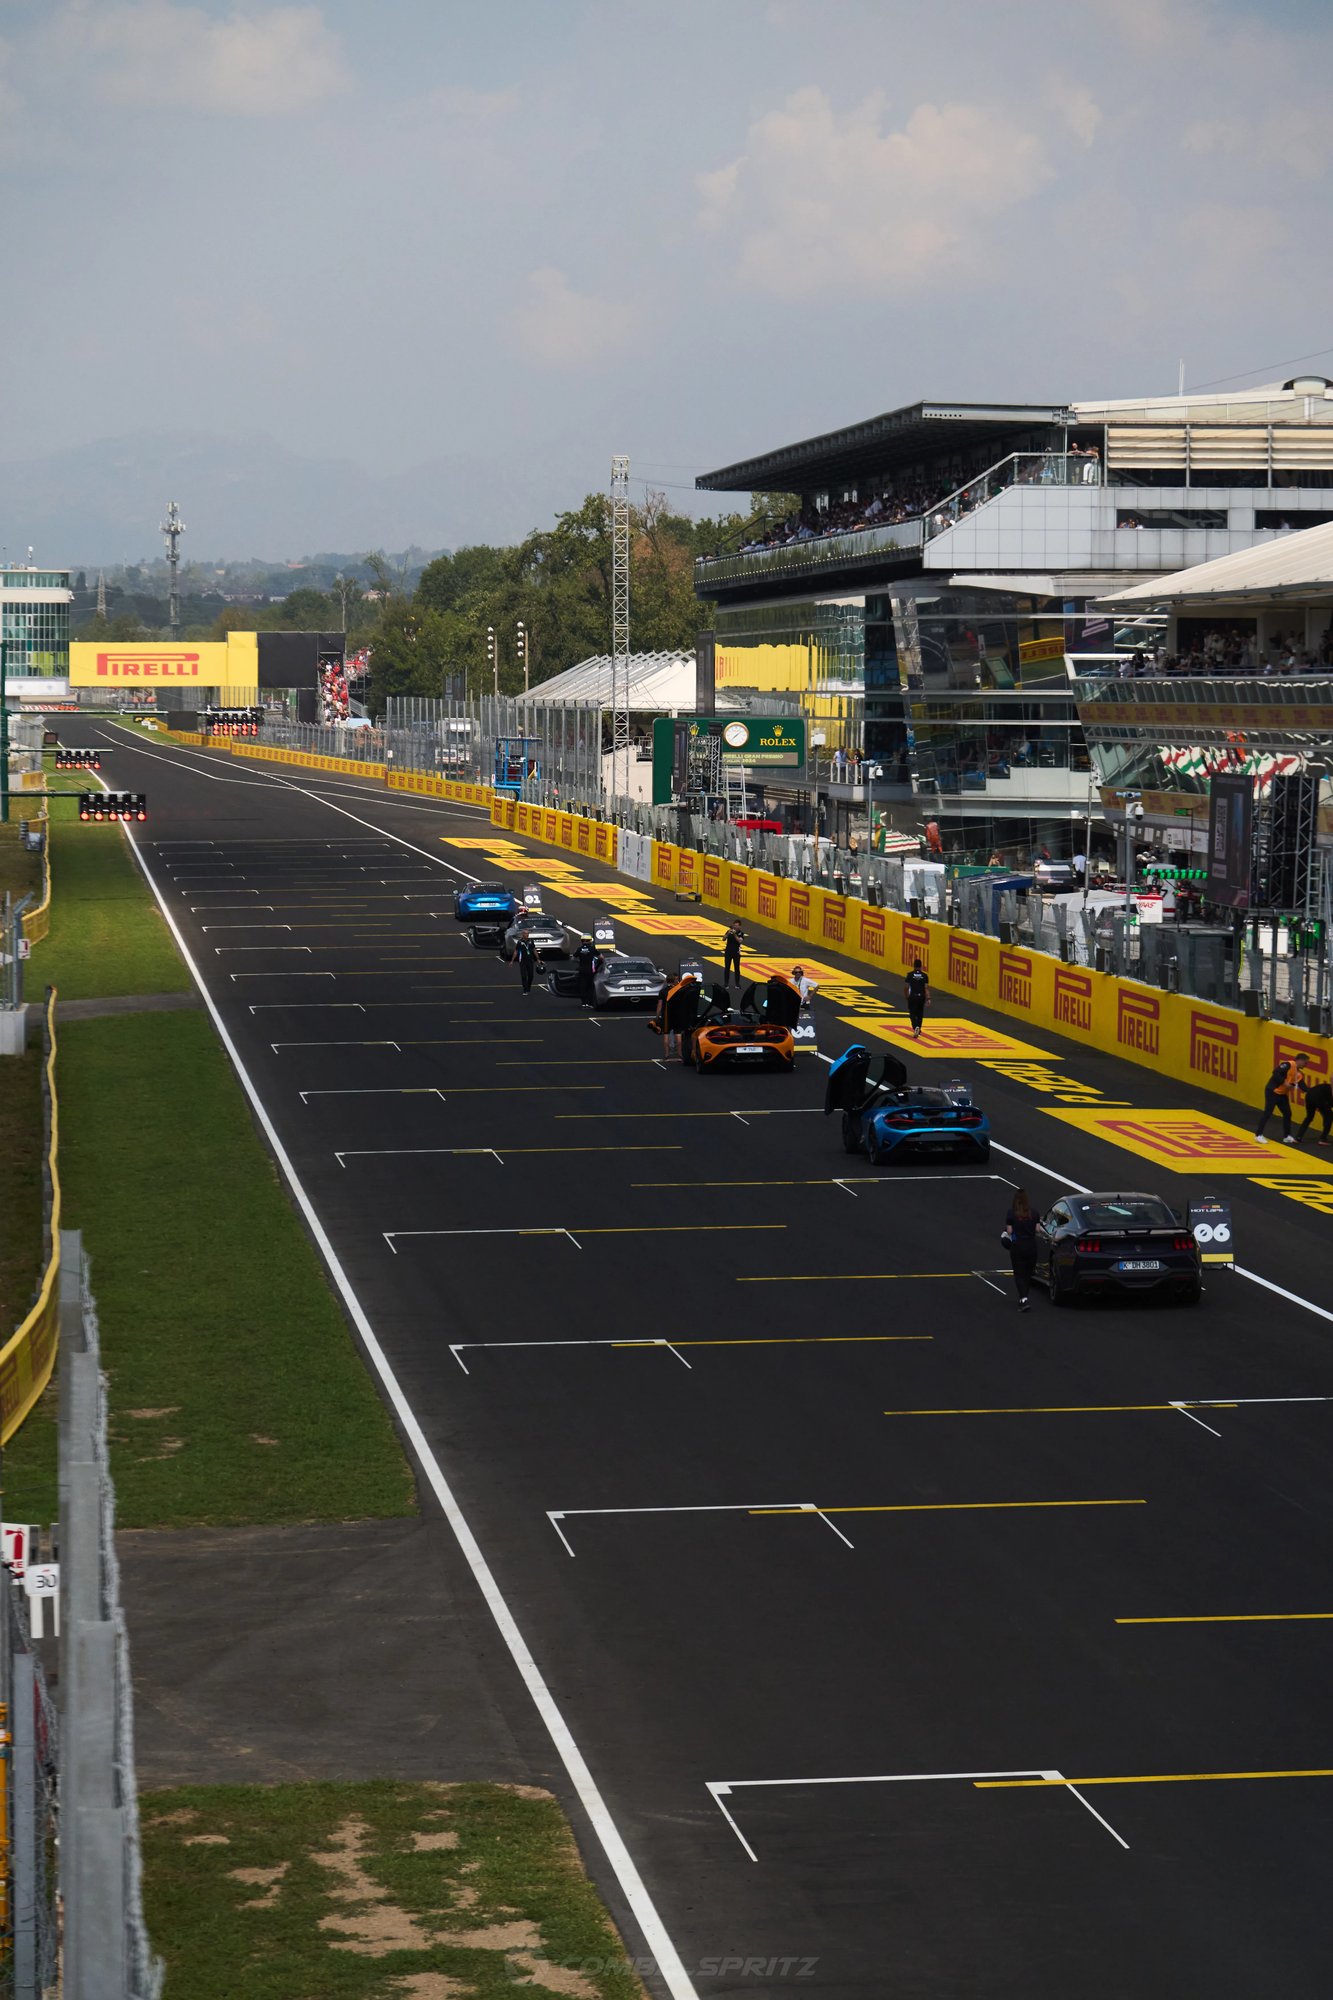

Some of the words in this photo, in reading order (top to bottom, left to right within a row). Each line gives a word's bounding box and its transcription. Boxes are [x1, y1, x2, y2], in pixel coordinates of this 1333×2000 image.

[96, 653, 200, 676] PIRELLI
[760, 738, 796, 746] ROLEX
[703, 860, 720, 899] PIRELLI
[730, 869, 747, 908] PIRELLI
[758, 878, 776, 919] PIRELLI
[525, 895, 540, 904] 01
[789, 886, 810, 931] PIRELLI
[596, 930, 614, 940] 02
[823, 897, 846, 944] PIRELLI
[860, 908, 885, 957] PIRELLI
[948, 934, 978, 990] PIRELLI
[999, 951, 1032, 1009] PIRELLI
[1054, 968, 1092, 1032] PIRELLI
[791, 1025, 815, 1038] 04
[1118, 988, 1160, 1056] PIRELLI
[1190, 1010, 1239, 1084] PIRELLI
[1094, 1120, 1287, 1159] PIRELLI
[1194, 1223, 1230, 1242] 06
[36, 1574, 56, 1588] 30
